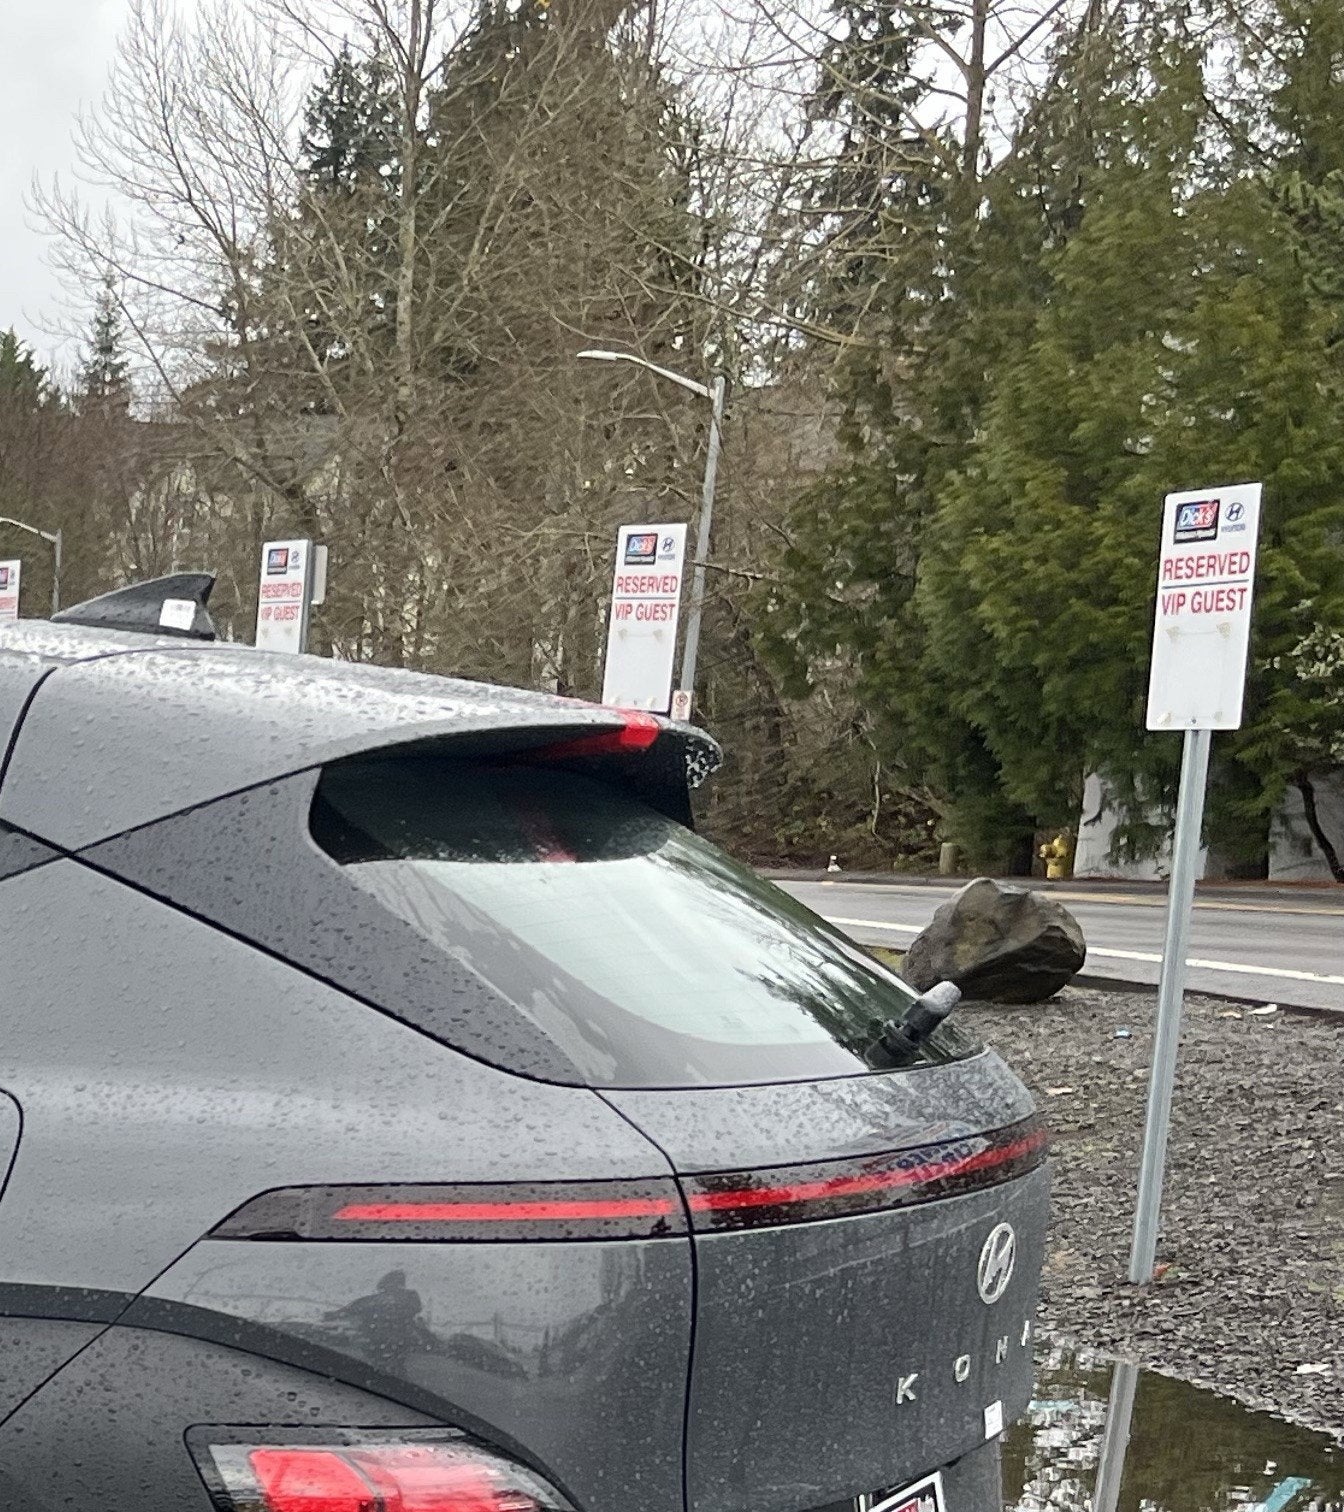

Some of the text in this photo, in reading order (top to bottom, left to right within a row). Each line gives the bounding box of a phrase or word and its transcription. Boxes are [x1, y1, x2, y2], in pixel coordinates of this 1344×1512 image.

[1162, 551, 1250, 581] RESERVED
[616, 575, 678, 593] RESERVED
[615, 603, 676, 621] VIP GUEST
[1162, 588, 1248, 616] VIP GUEST
